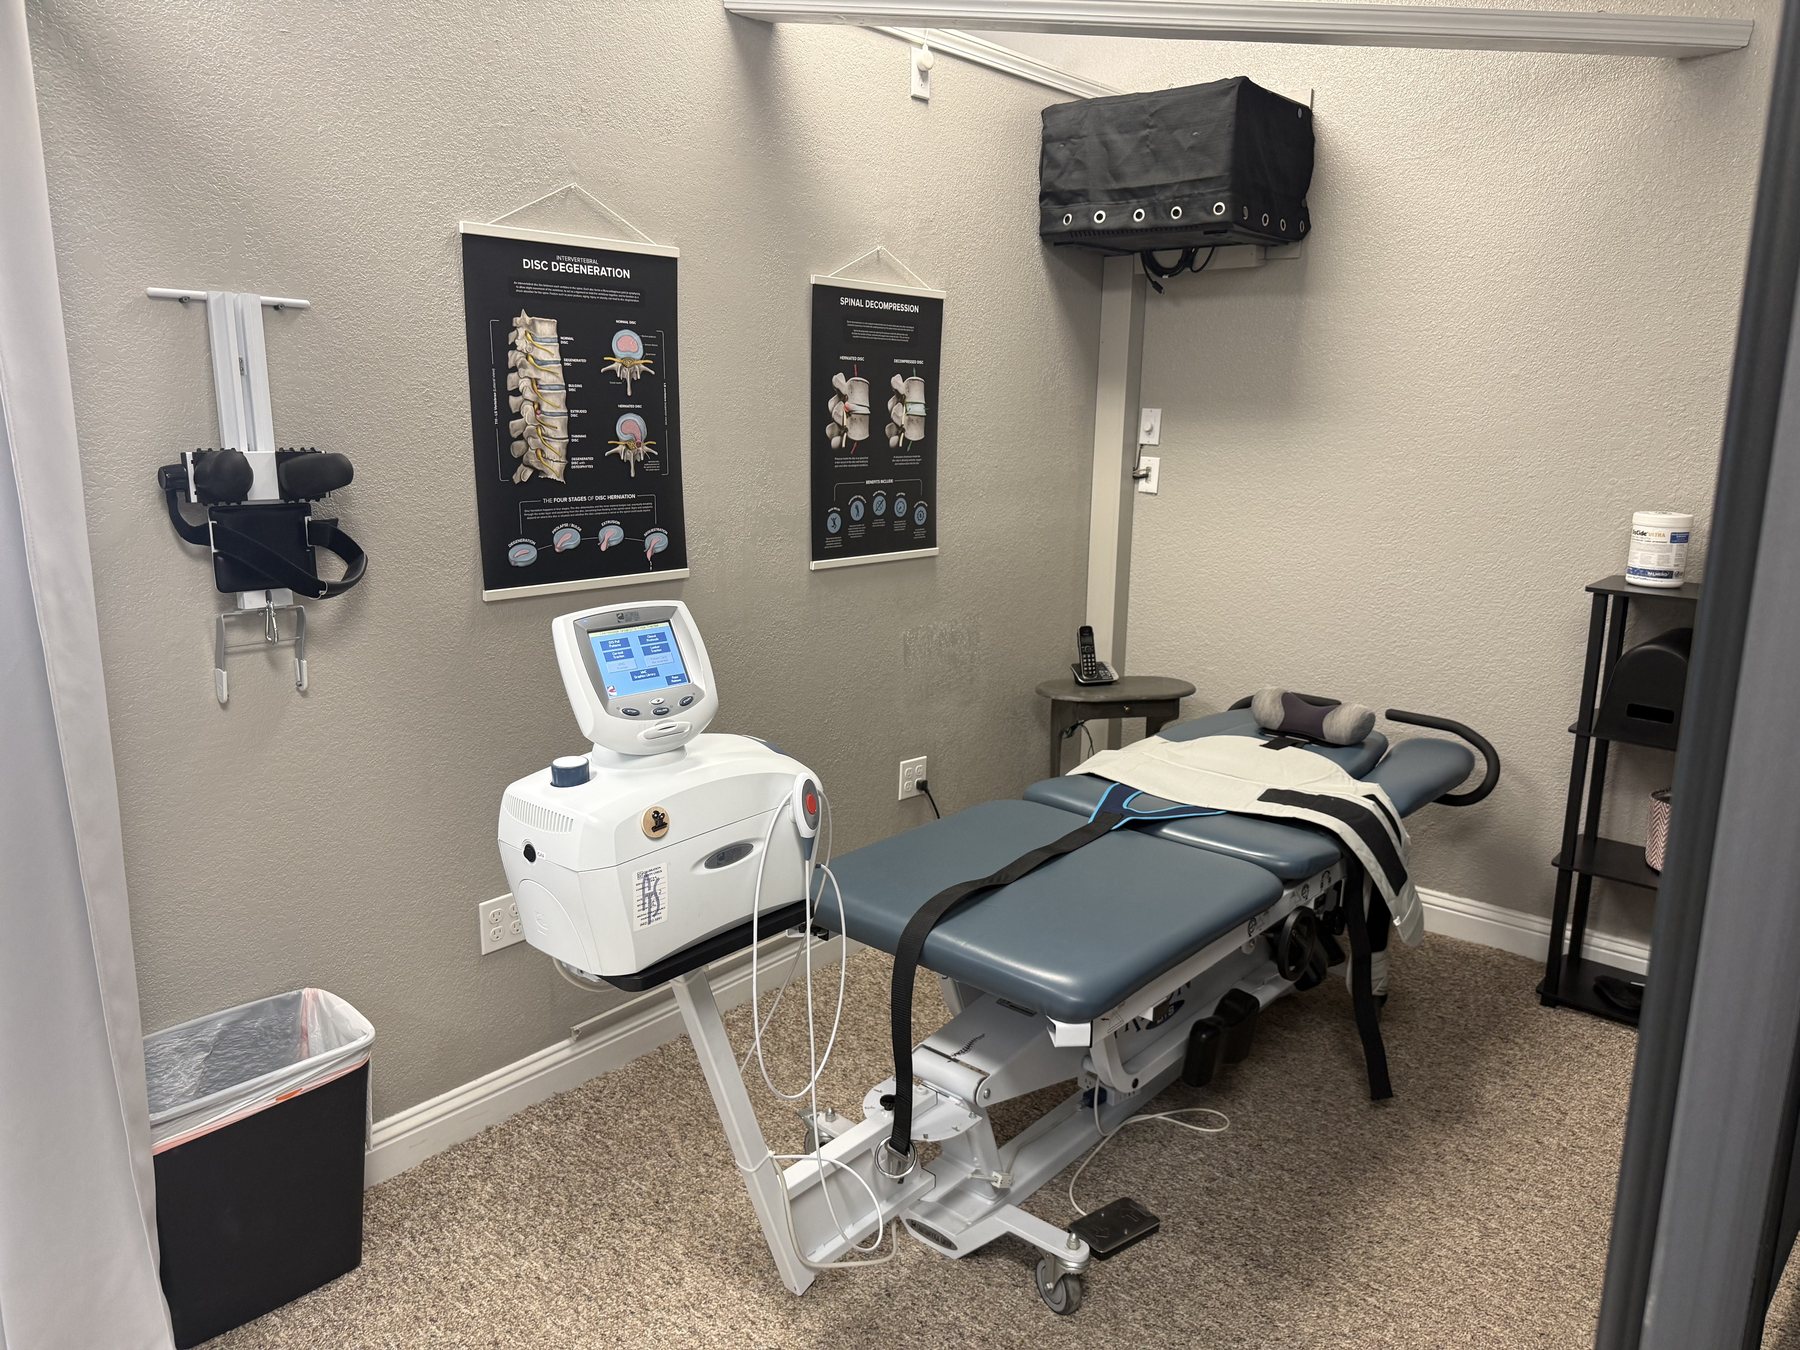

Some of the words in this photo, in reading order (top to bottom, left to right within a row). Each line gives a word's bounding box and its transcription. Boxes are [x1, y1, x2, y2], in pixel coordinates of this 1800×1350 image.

[522, 258, 549, 271] DISC
[551, 261, 631, 279] DEGENERATION
[556, 255, 598, 265] INTERVERTEBRAL
[840, 296, 864, 308] SPINAL
[865, 299, 920, 314] DECOMPRESSION
